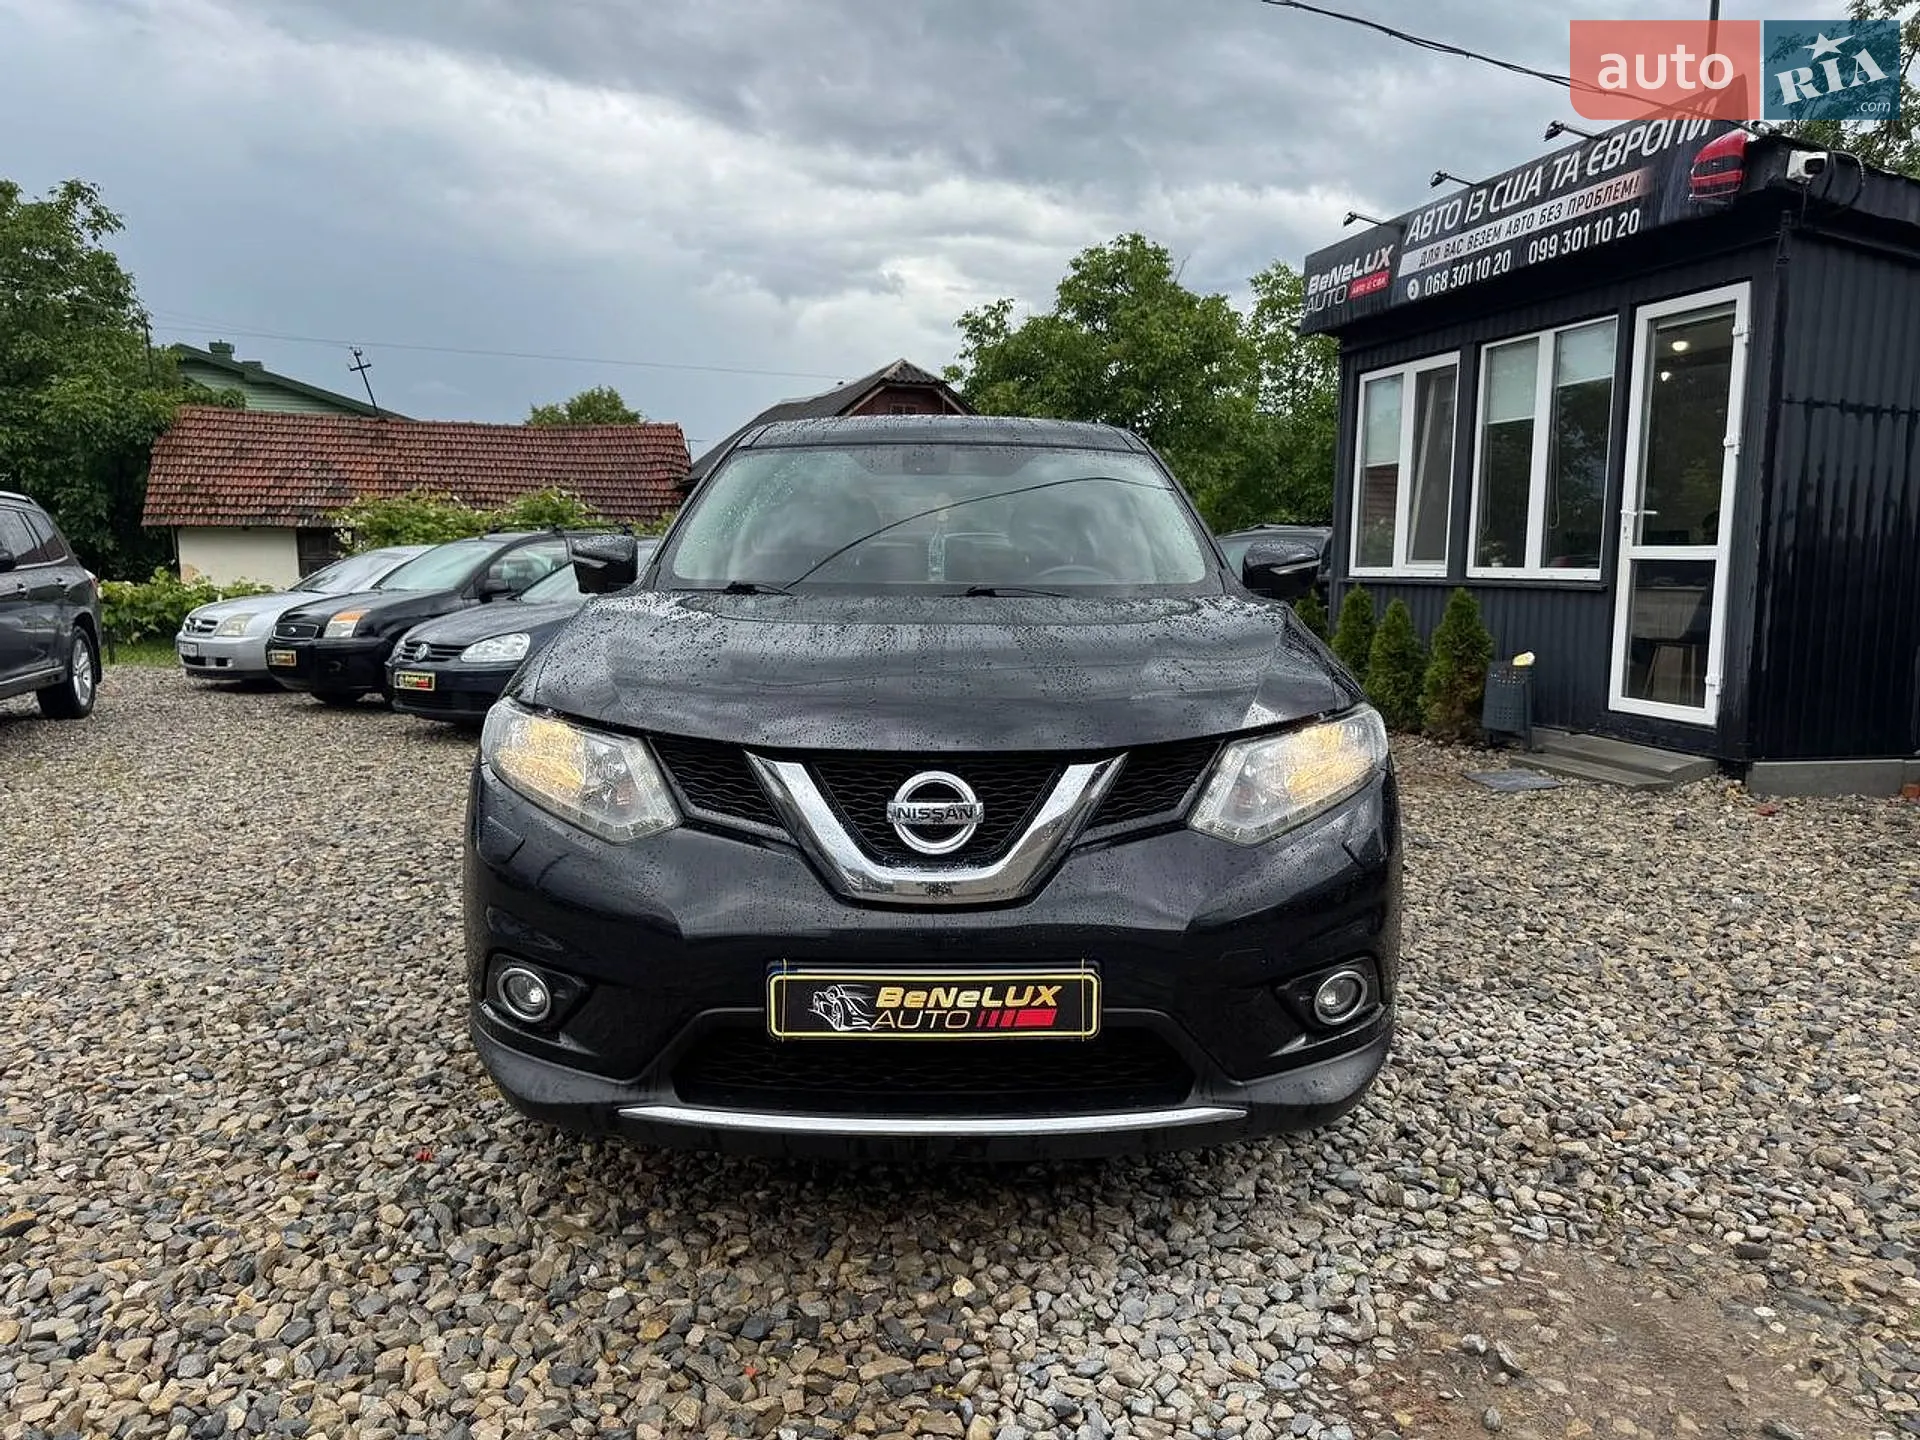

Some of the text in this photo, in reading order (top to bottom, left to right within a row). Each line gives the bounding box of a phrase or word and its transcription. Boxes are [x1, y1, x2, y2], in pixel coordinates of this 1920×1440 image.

[1405, 198, 1462, 246] АВТО
[1464, 188, 1487, 223] ІЗ
[1489, 165, 1543, 213] США
[1550, 150, 1581, 191] ТА
[1443, 237, 1464, 260] ВАС
[1466, 224, 1502, 251] ВЕЗЕМ
[1505, 212, 1535, 236] АВТО
[1538, 202, 1563, 221] БЕЗ
[1567, 175, 1640, 216] ПРОБЛЕМ!
[1528, 208, 1640, 265] 099 301 10 20
[1307, 244, 1394, 296] BeNeLUX
[1425, 249, 1511, 296] 068 301 10 20
[1306, 284, 1347, 312] AUTO
[896, 806, 973, 819] NISSAN
[873, 1010, 970, 1029] AUTO
[876, 985, 1062, 1008] BeNeLUX
